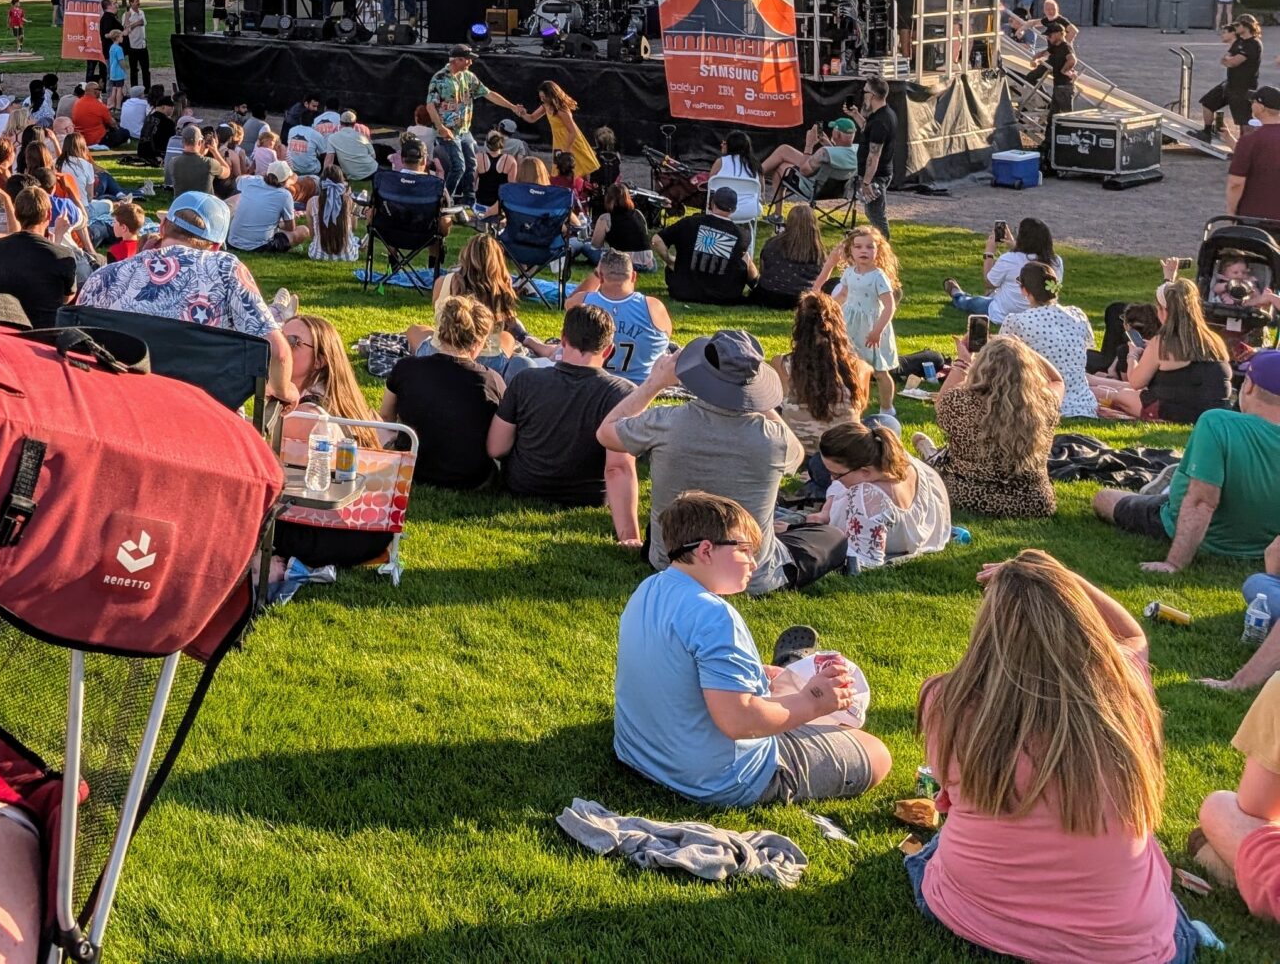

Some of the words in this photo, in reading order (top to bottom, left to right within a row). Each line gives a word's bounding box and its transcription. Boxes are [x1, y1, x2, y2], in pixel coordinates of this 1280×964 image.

[699, 64, 759, 82] SAMSUNG
[669, 82, 704, 95] boldyn
[718, 85, 735, 96] IBM
[759, 92, 797, 101] amdocs
[618, 320, 643, 340] RAY
[602, 342, 636, 373] 27
